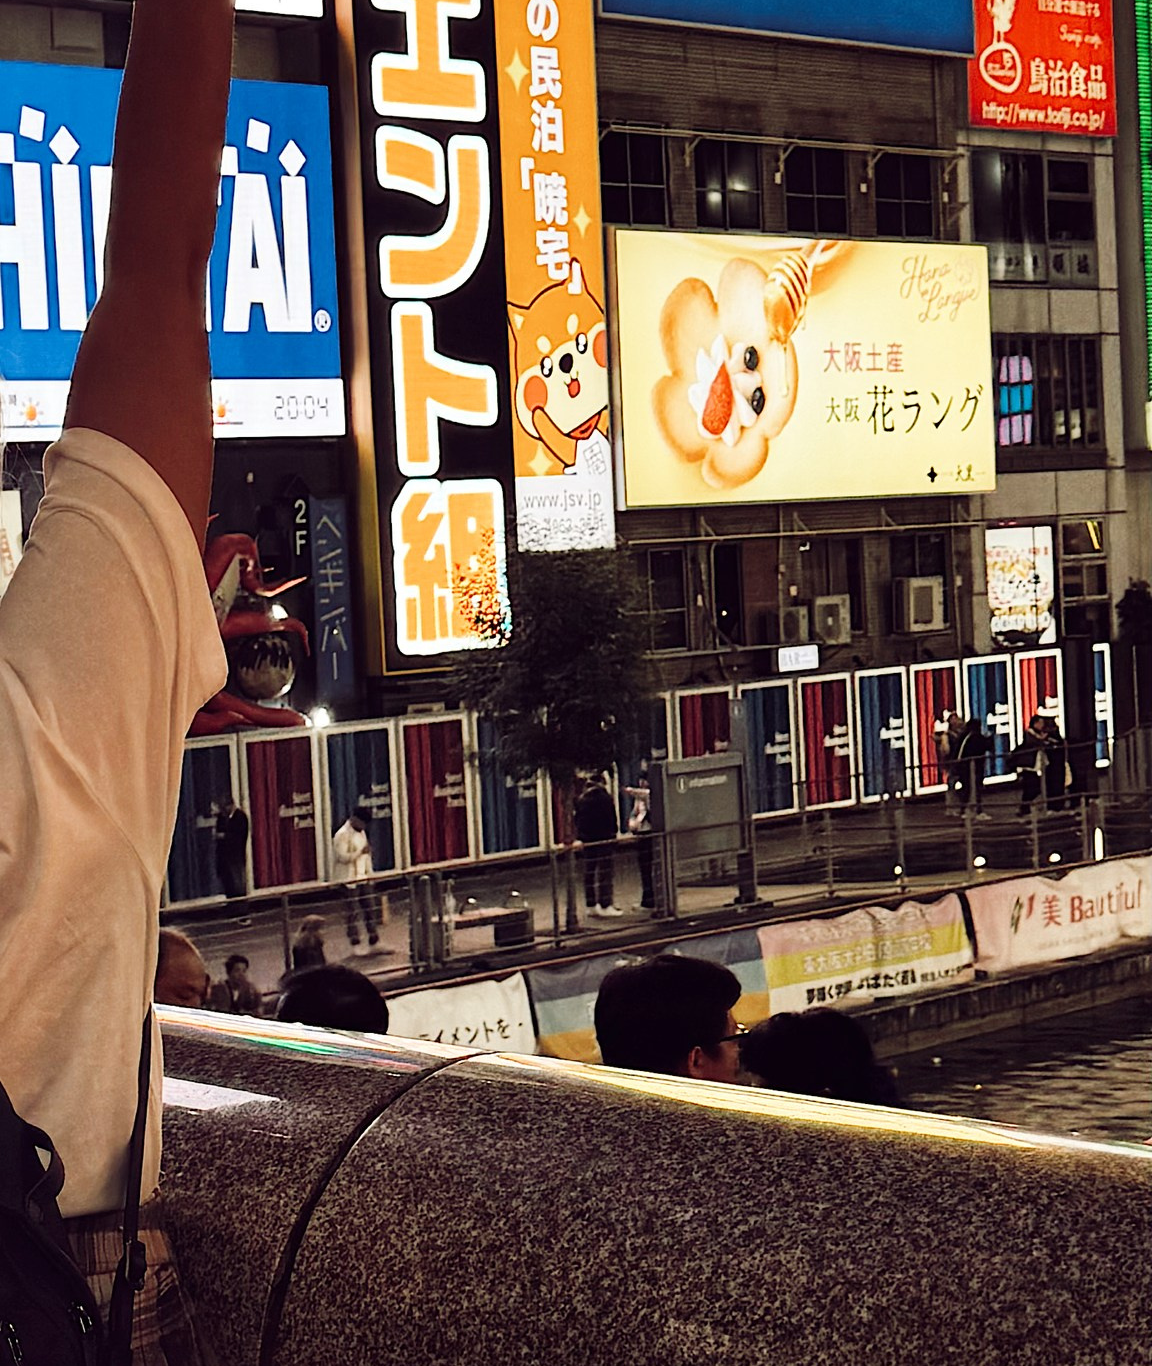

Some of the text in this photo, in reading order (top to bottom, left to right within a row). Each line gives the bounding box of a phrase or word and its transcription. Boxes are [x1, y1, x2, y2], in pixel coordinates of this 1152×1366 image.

[823, 341, 905, 373] 大阪土産
[273, 394, 329, 420] 20:04
[825, 383, 984, 435] 大阪 花ラング
